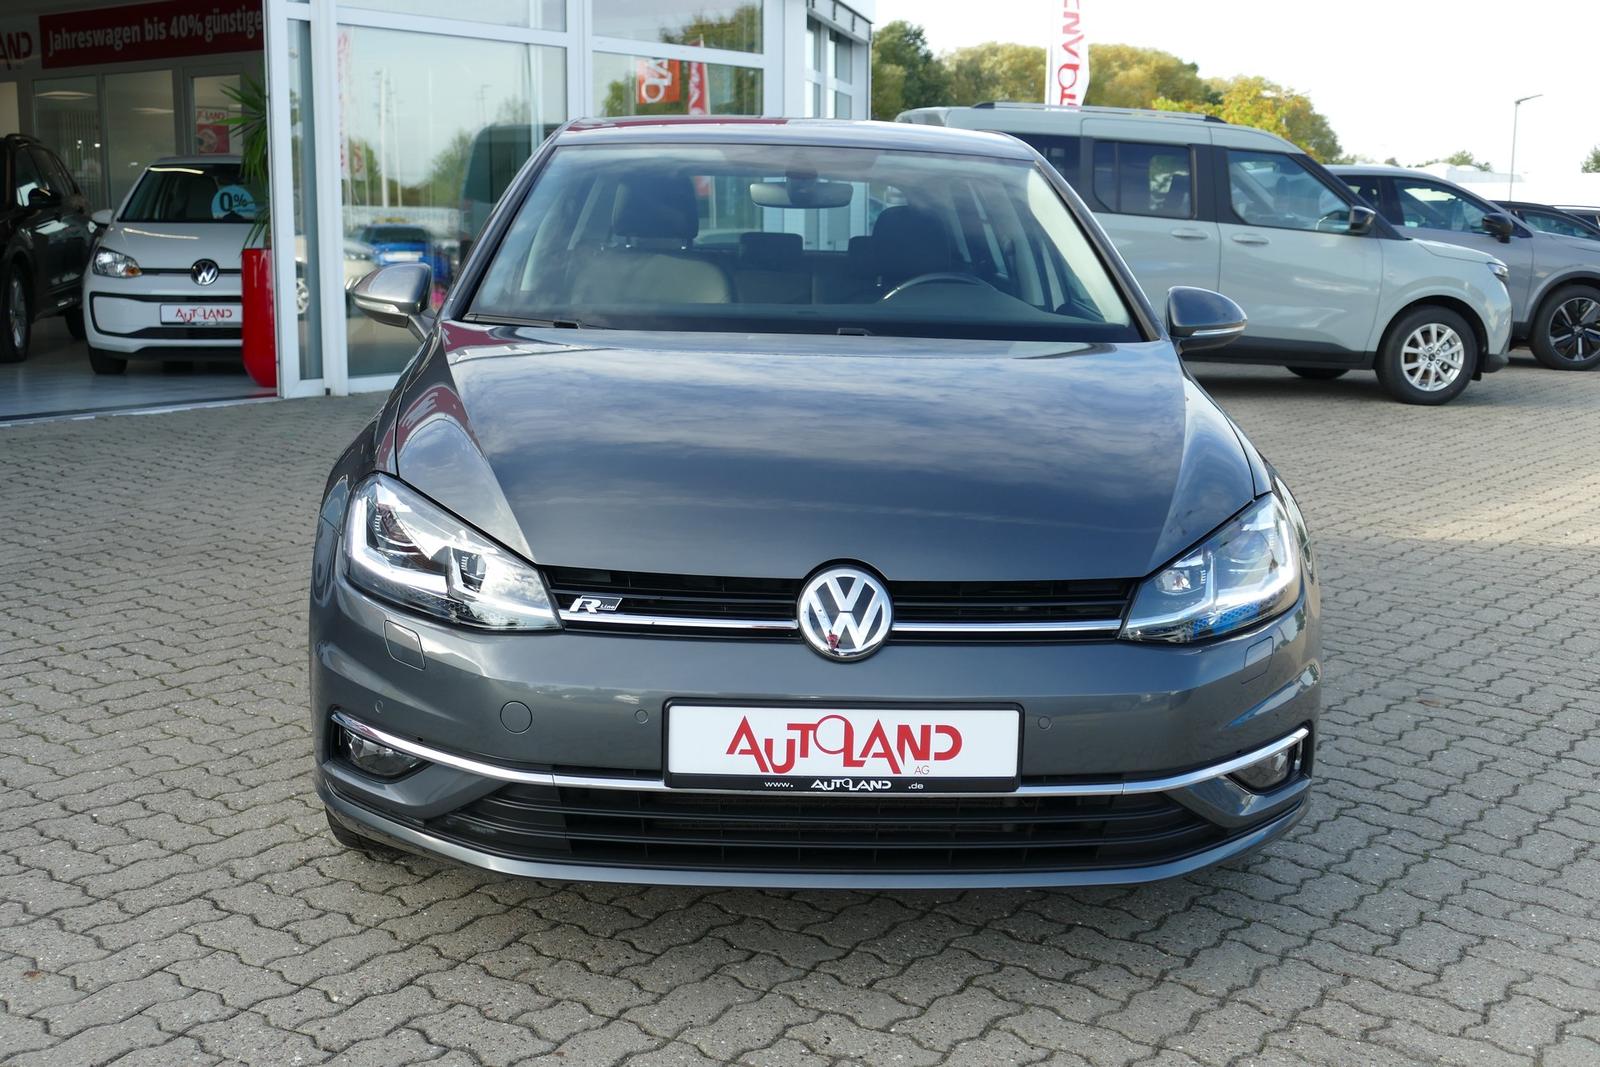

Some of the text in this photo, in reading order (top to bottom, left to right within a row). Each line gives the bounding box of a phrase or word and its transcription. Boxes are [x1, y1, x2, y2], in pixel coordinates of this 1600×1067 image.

[49, 25, 139, 56] Jahreswagen
[144, 17, 166, 41] bis
[170, 13, 203, 40] 40%
[220, 192, 247, 212] 0%
[176, 307, 232, 323] AUTOLAND
[726, 714, 962, 775] AUTOLAND
[914, 765, 930, 775] AG
[811, 778, 891, 791] AUTOLAND
